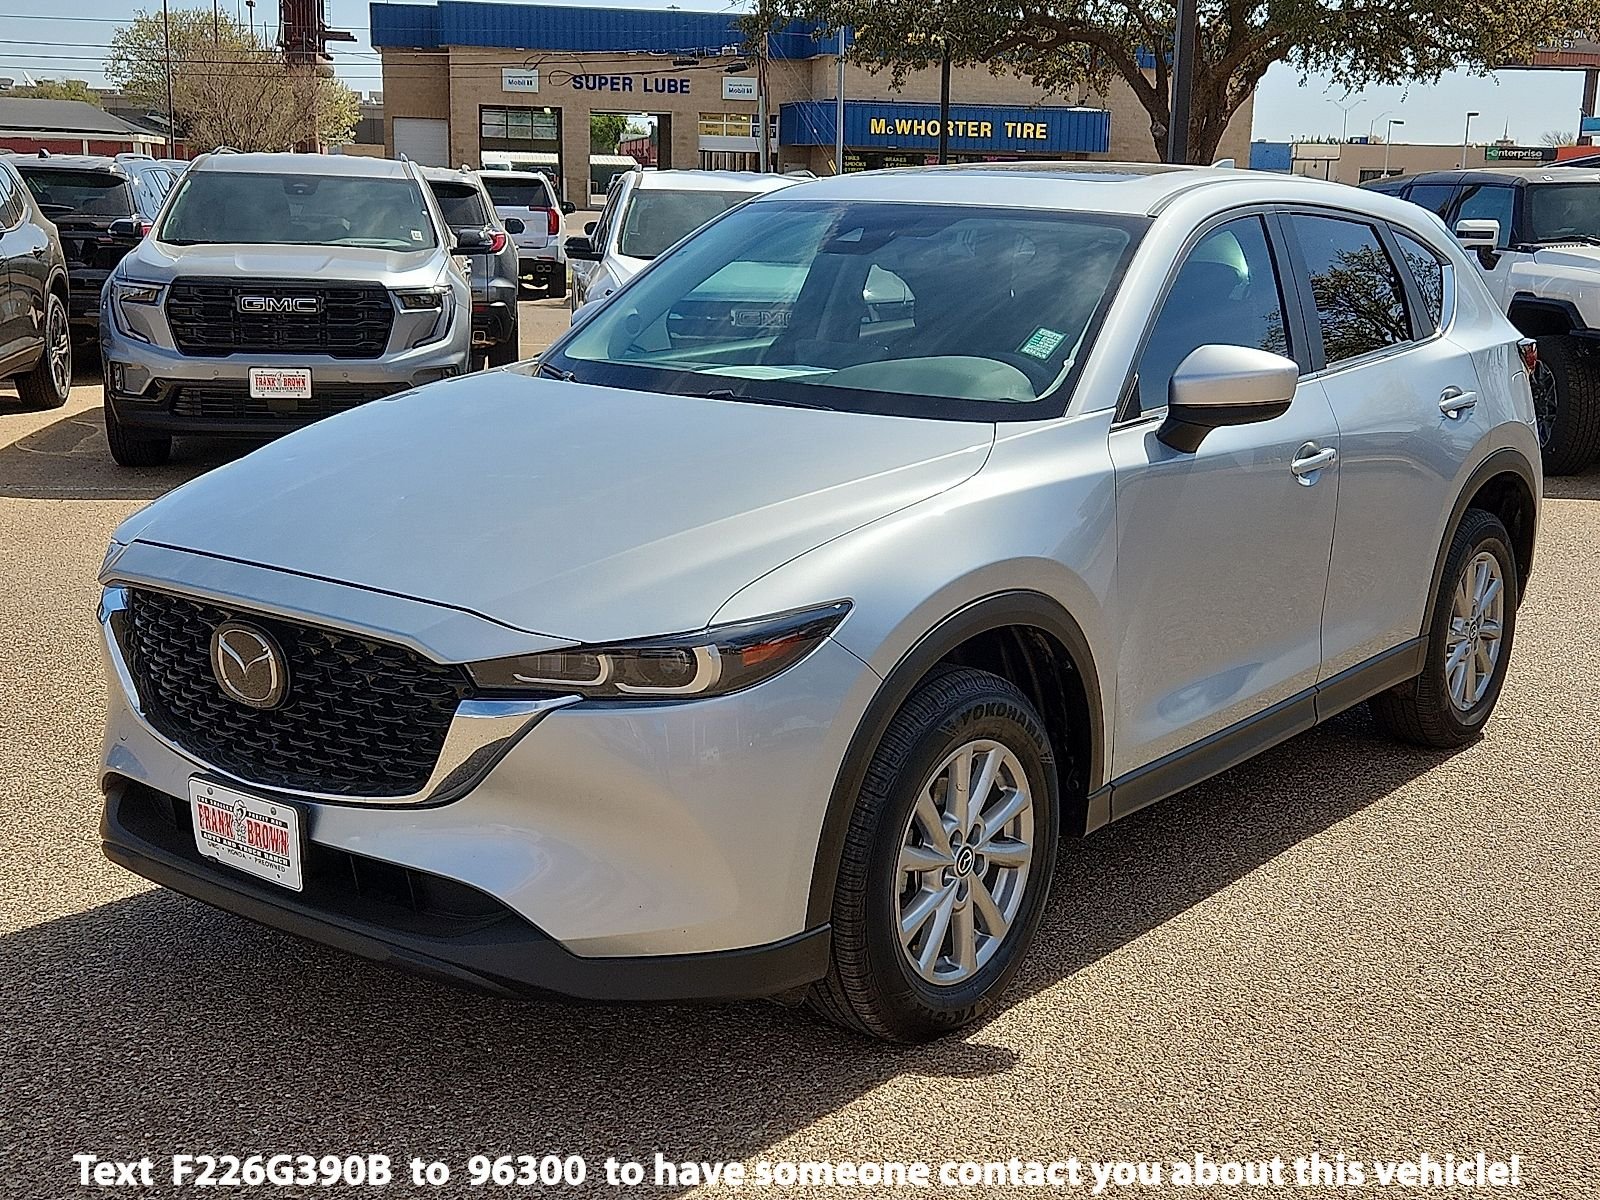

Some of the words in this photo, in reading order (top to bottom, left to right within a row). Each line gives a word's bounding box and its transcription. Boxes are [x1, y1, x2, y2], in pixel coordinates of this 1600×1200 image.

[572, 75, 634, 93] SUPER
[643, 77, 692, 95] LUBE
[870, 118, 992, 138] McWHORTER
[1004, 122, 1048, 140] TIRE
[1487, 149, 1543, 159] enterprise
[241, 297, 317, 312] GMC
[255, 376, 277, 388] FRANK
[283, 377, 306, 388] BROWN
[960, 702, 1045, 751] YOKOHAMA
[197, 803, 235, 840] FRANK
[246, 819, 290, 858] BROWN
[263, 851, 290, 867] RANCH
